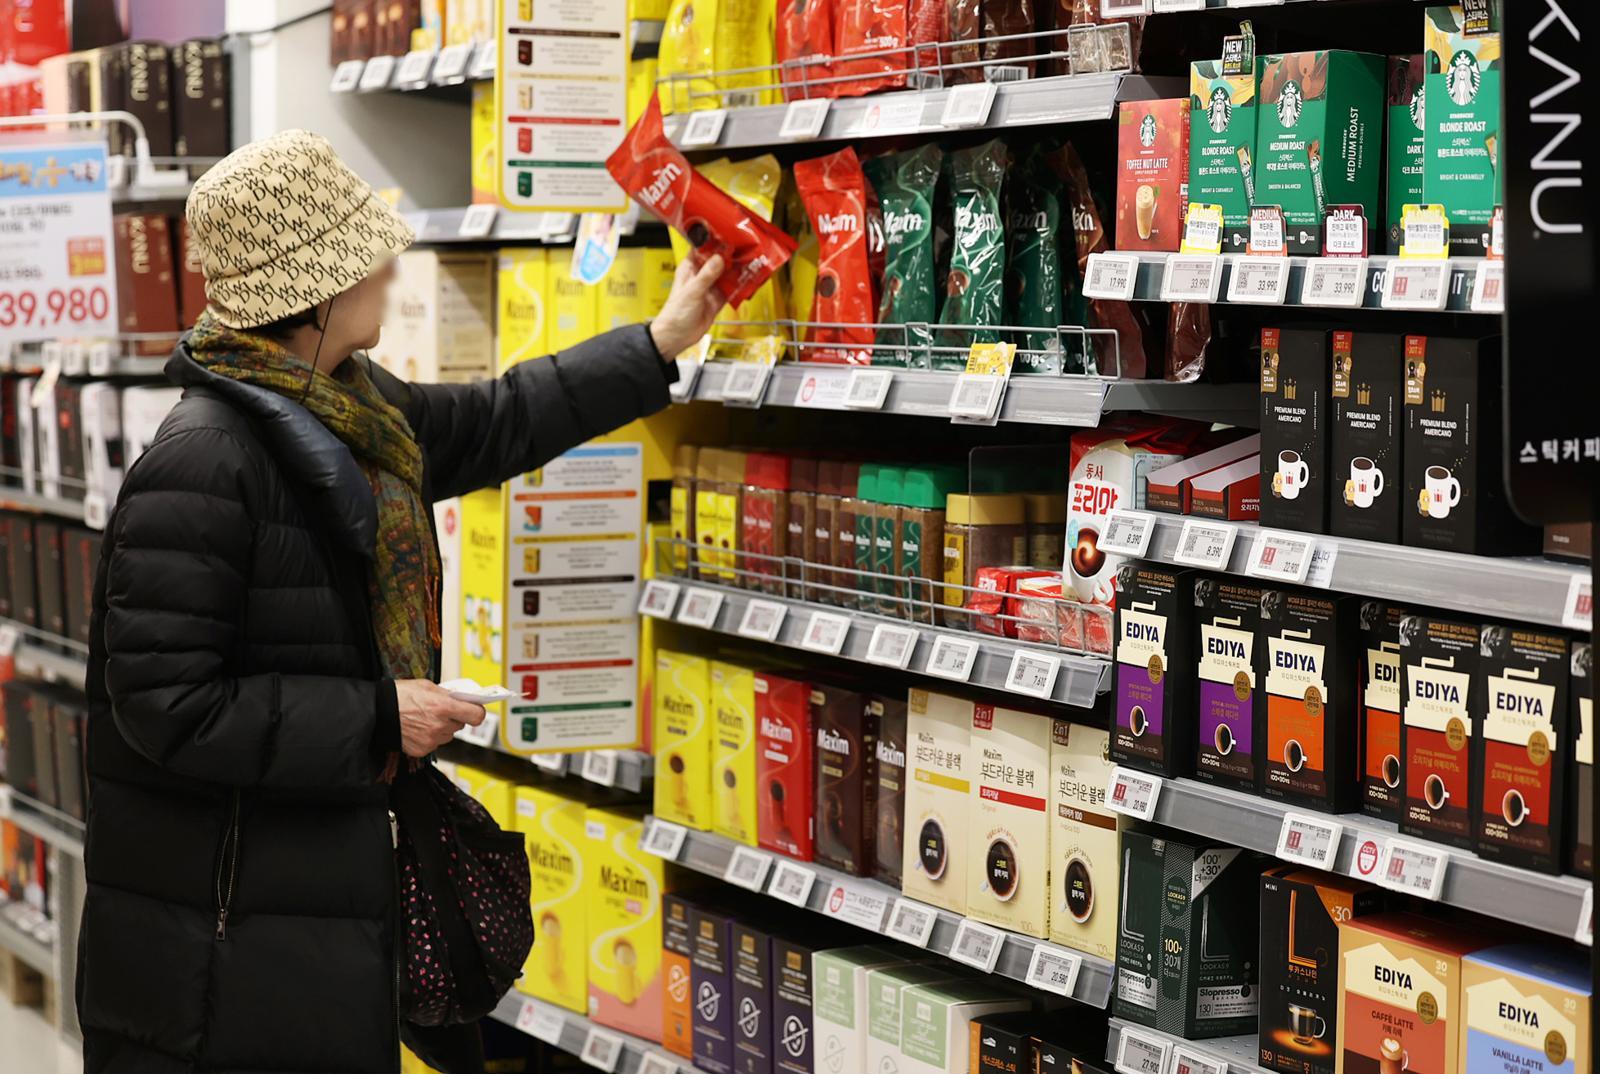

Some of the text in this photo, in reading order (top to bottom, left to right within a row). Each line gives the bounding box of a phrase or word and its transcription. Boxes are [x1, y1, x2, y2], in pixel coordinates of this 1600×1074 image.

[1226, 40, 1243, 53] NEW
[131, 42, 149, 101] KANU
[185, 41, 204, 99] KANU
[1440, 120, 1486, 133] BLONDE ROAST
[1202, 146, 1235, 156] BLONDE ROAST
[1269, 141, 1305, 151] MEDIUM ROAST
[1346, 107, 1360, 182] MEDIUM ROAST
[1407, 145, 1421, 154] DARK
[1127, 157, 1168, 170] TOFFEE NUT LATTE
[1252, 209, 1280, 220] MEDIUM
[1333, 209, 1356, 221] DARK
[1274, 406, 1306, 416] PREMIUM BLEND
[1278, 414, 1301, 423] AMERICANO
[1346, 411, 1381, 421] PREMIUM BLEND
[1350, 420, 1376, 430] AMERICANO
[1420, 418, 1457, 430] PREMIUM BLEND
[1424, 428, 1452, 438] AMERICANO
[1520, 438, 1600, 464] 스틱커피
[1086, 463, 1104, 481] 동서
[1072, 483, 1118, 515] 프리마
[1126, 621, 1159, 643] EDIYA
[1208, 637, 1245, 659] EDIYA
[1275, 650, 1317, 674] EDIYA
[1416, 680, 1460, 703] EDIYA
[663, 695, 694, 717] Maxim
[1496, 691, 1543, 716] EDIYA
[975, 707, 992, 720] 2in1
[760, 718, 792, 743] Maxim
[1053, 722, 1068, 735] 2in1
[817, 728, 850, 756] Maxim
[876, 739, 905, 768] Maxim
[916, 745, 962, 771] 부드러운 블랙
[982, 748, 1003, 761] Maxim
[980, 763, 1035, 788] 부드러운 블랙
[1061, 764, 1076, 778] Maxim
[1058, 780, 1088, 802] 부드러운
[529, 842, 574, 876] Maxim
[600, 865, 649, 899] Maxim
[1265, 883, 1278, 891] MINI
[1288, 964, 1318, 980] 루카스나인
[1435, 960, 1447, 972] 30
[1374, 965, 1413, 991] EDIYA
[1199, 989, 1240, 999] Slopresso
[1393, 1015, 1414, 1031] LATTE
[1498, 1001, 1539, 1029] EDIYA
[1492, 1047, 1544, 1072] VANILLA LATTE
